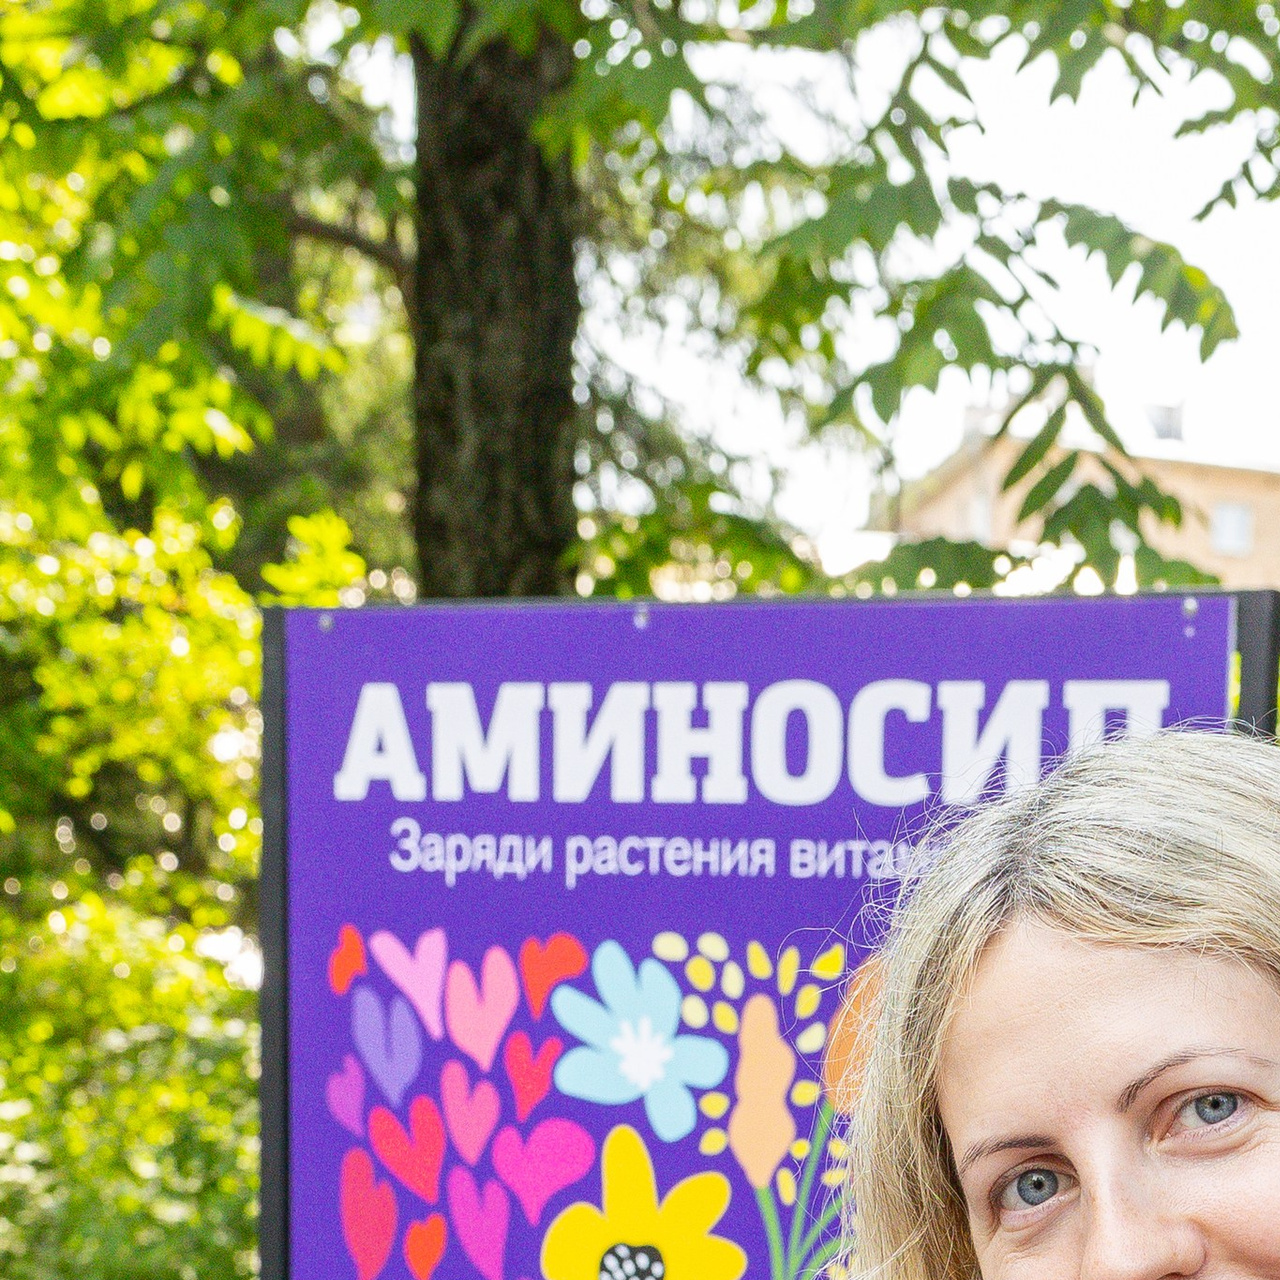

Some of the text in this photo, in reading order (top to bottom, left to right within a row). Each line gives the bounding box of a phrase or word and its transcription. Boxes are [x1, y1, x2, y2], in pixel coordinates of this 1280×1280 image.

[389, 817, 912, 889] Заряди растения вита
